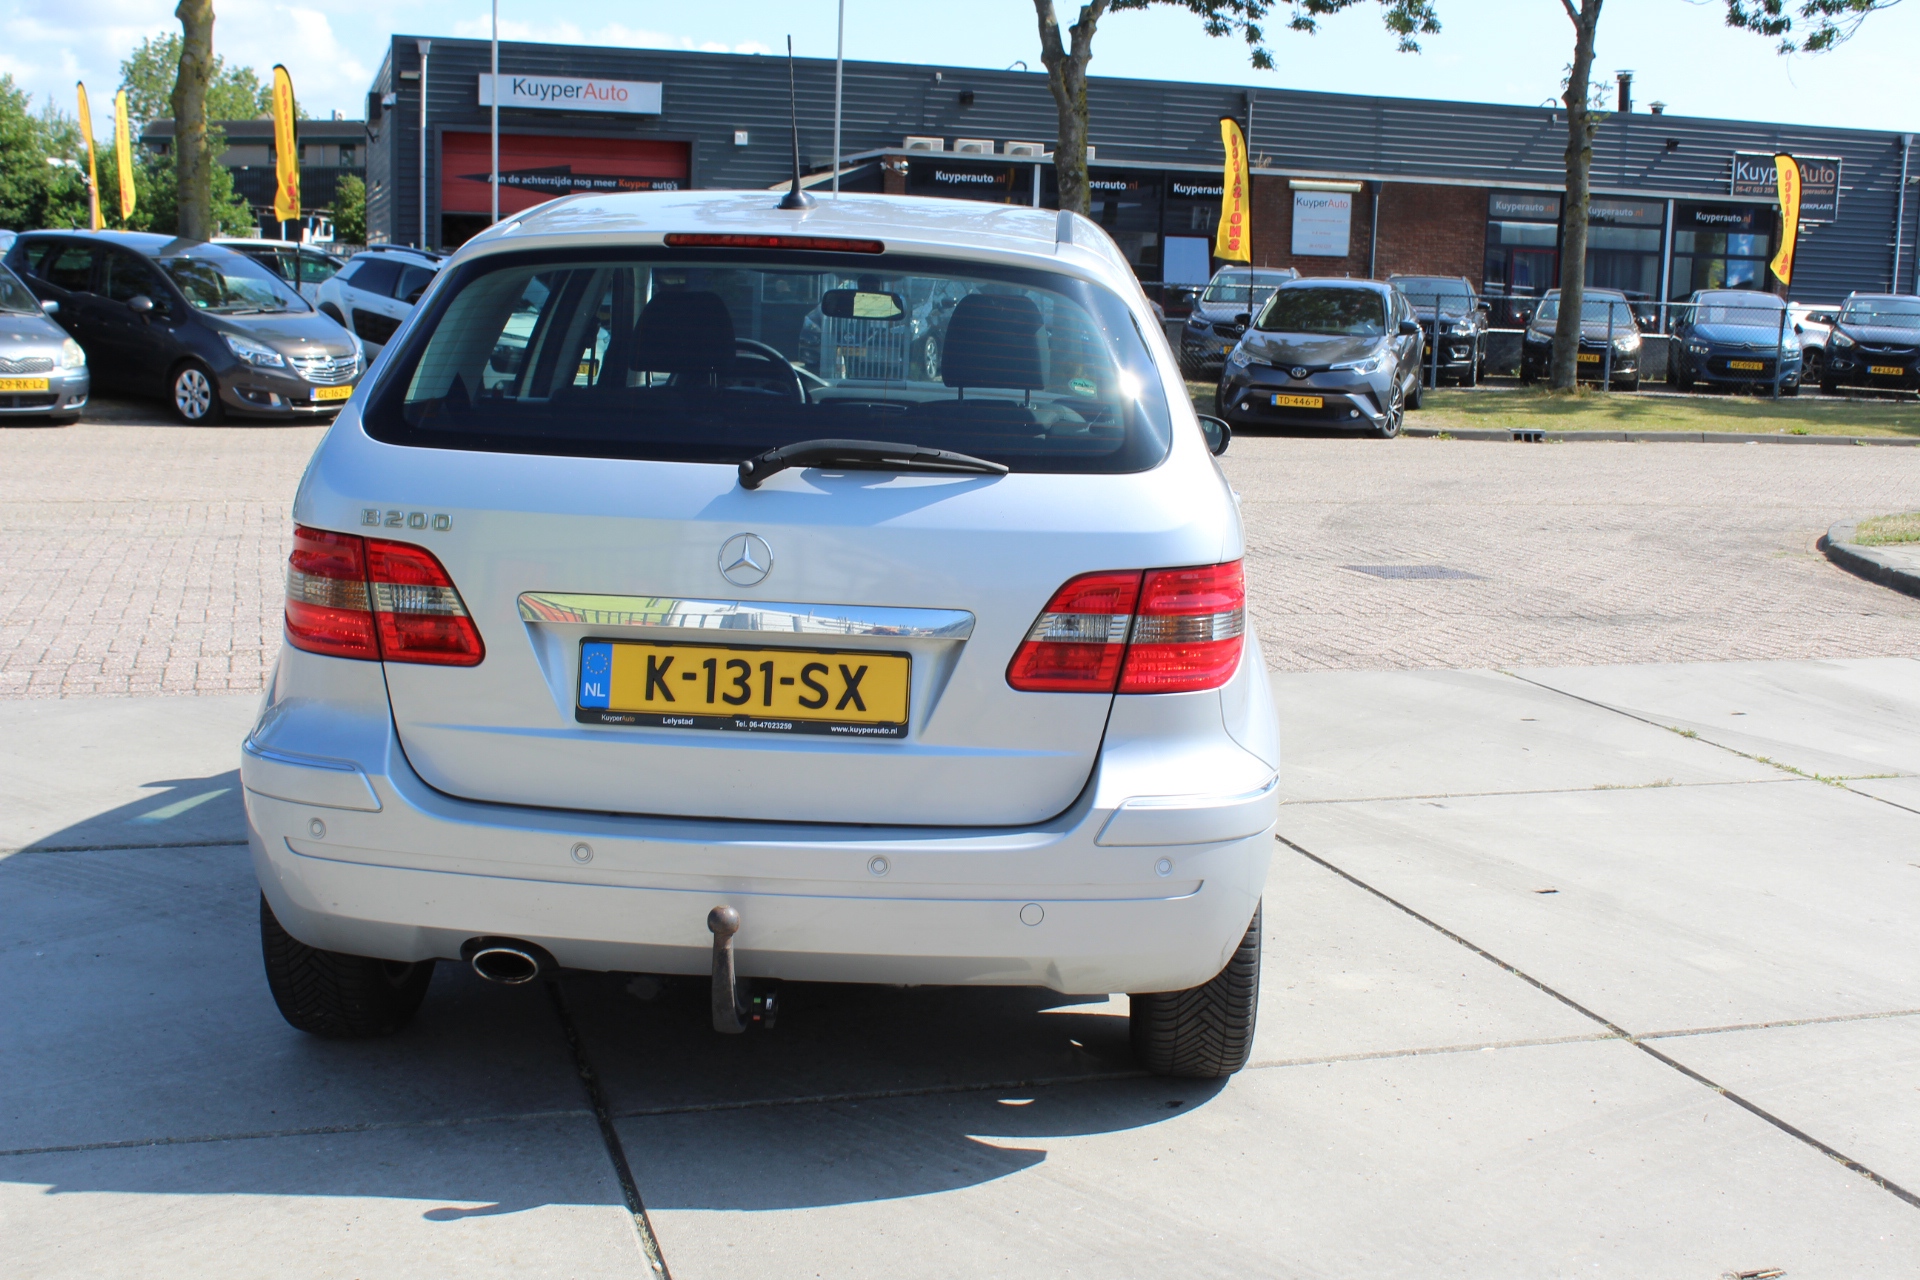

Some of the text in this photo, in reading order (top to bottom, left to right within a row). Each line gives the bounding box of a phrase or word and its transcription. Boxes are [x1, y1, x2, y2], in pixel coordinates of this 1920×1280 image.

[513, 78, 629, 102] KuyperAuto
[508, 174, 520, 184] de
[521, 174, 572, 188] achterzijde
[573, 179, 592, 189] nog
[593, 179, 617, 188] meer
[618, 178, 650, 190] Kuyper
[651, 181, 678, 190] auto's
[935, 170, 1006, 184] Kuyperauto.nl
[1088, 180, 1138, 190] perauto.nl
[1296, 197, 1349, 209] KuyperAuto
[1495, 201, 1555, 213] Kuyperauto.nl
[1800, 203, 1834, 211] ERKPLAATS
[1695, 211, 1751, 224] Kuyperauto.nl
[1278, 396, 1320, 406] TD-446-P
[361, 508, 453, 532] B200
[584, 682, 606, 697] NL
[645, 654, 869, 712] K-131-SX
[601, 714, 898, 735] KuyperAuto Lelystad Tel. 06-47023259 www.kuyperauto.nl
